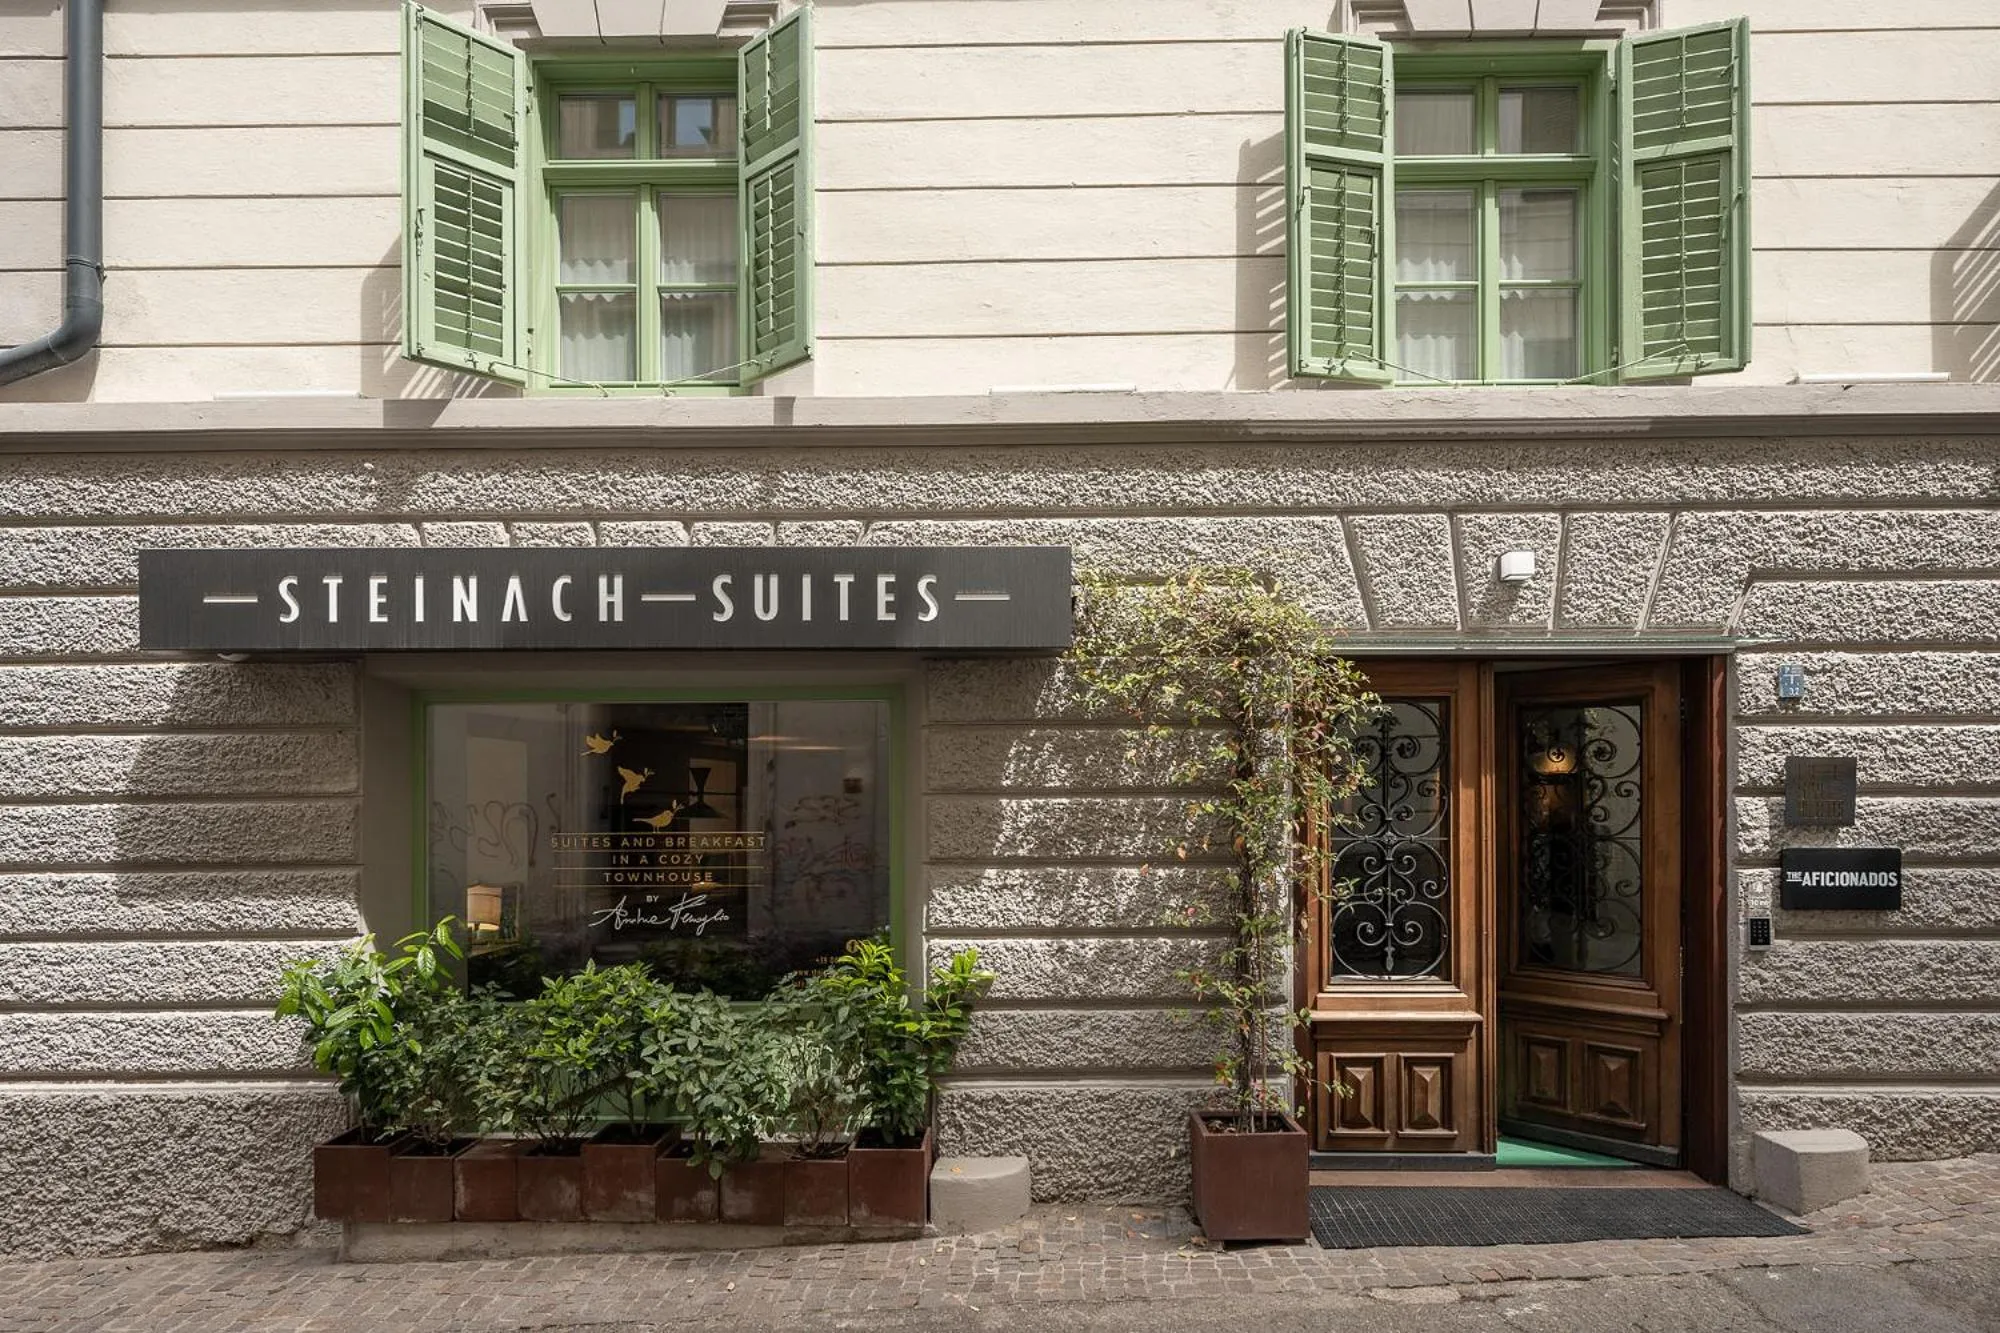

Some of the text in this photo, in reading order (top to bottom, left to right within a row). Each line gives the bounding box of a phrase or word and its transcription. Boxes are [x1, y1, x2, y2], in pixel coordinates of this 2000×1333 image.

[277, 573, 940, 623] STEINACH SUITES
[551, 836, 766, 849] SUITES AND BREAKFAST
[612, 854, 704, 864] IN A COZY
[604, 872, 713, 882] TOWNHOUSE
[1786, 871, 1899, 887] THE AFICIONADOS
[646, 895, 660, 903] BY
